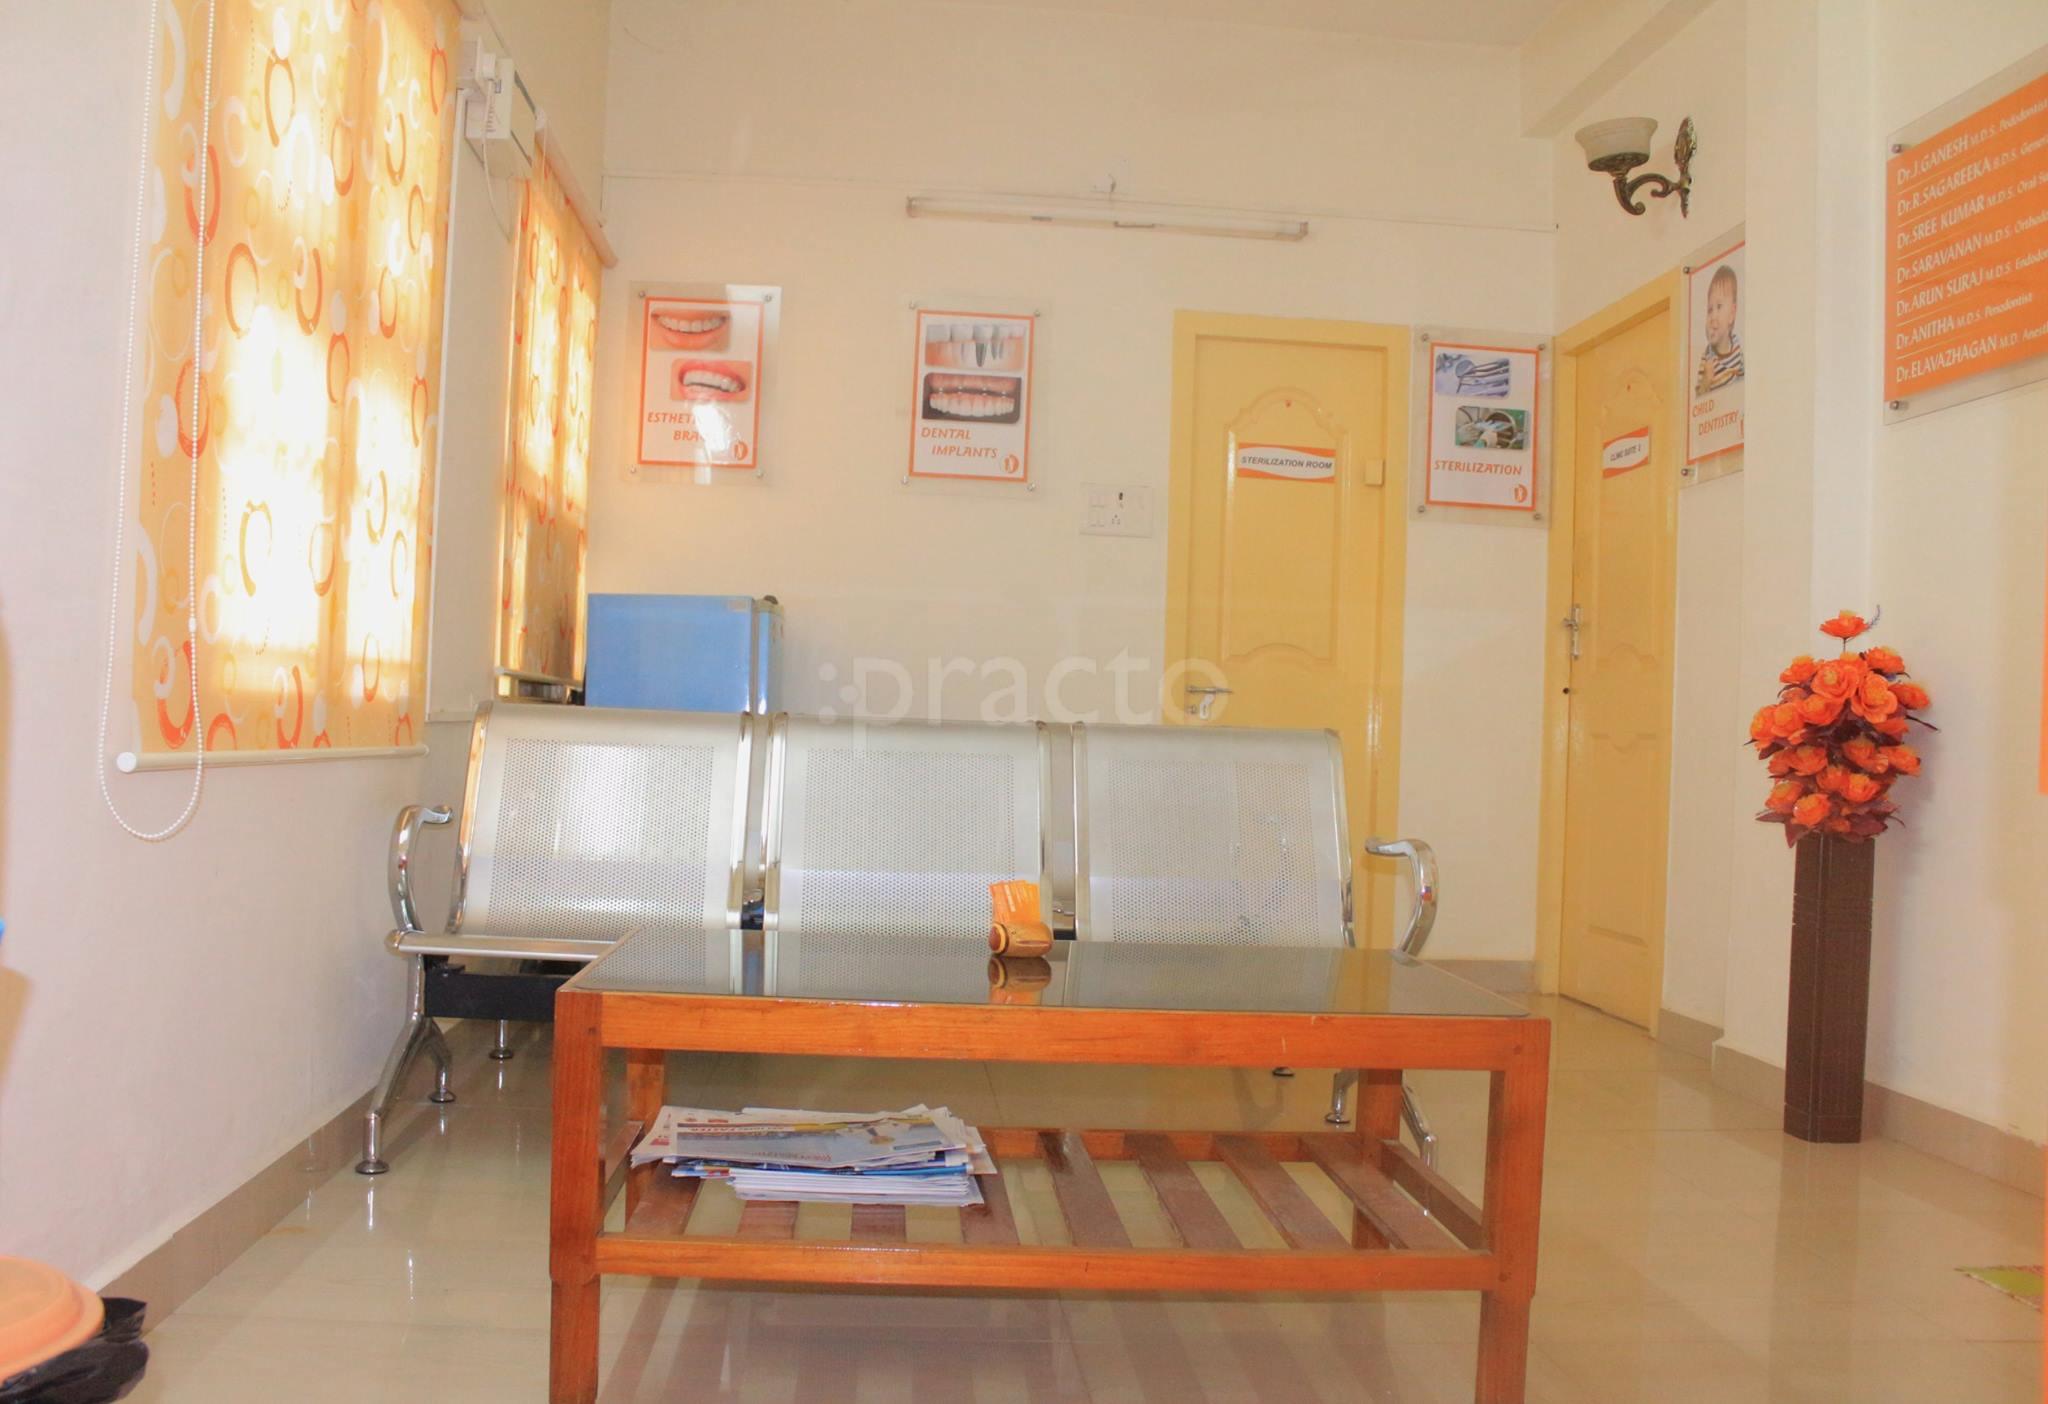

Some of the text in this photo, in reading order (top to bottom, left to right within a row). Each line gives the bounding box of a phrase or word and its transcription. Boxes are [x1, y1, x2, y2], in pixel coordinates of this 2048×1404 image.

[1941, 195, 1984, 230] KUMAR
[1947, 267, 1984, 298] SURAJ
[1692, 399, 1713, 418] CHILD
[1698, 410, 1739, 436] DENTISTRY
[673, 430, 704, 442] BRA
[921, 427, 972, 440] DENTAL
[932, 445, 998, 459] IMPLANTS
[1241, 455, 1333, 470] STERILIZATION ROOM
[1434, 459, 1522, 475] STERILIZATION
